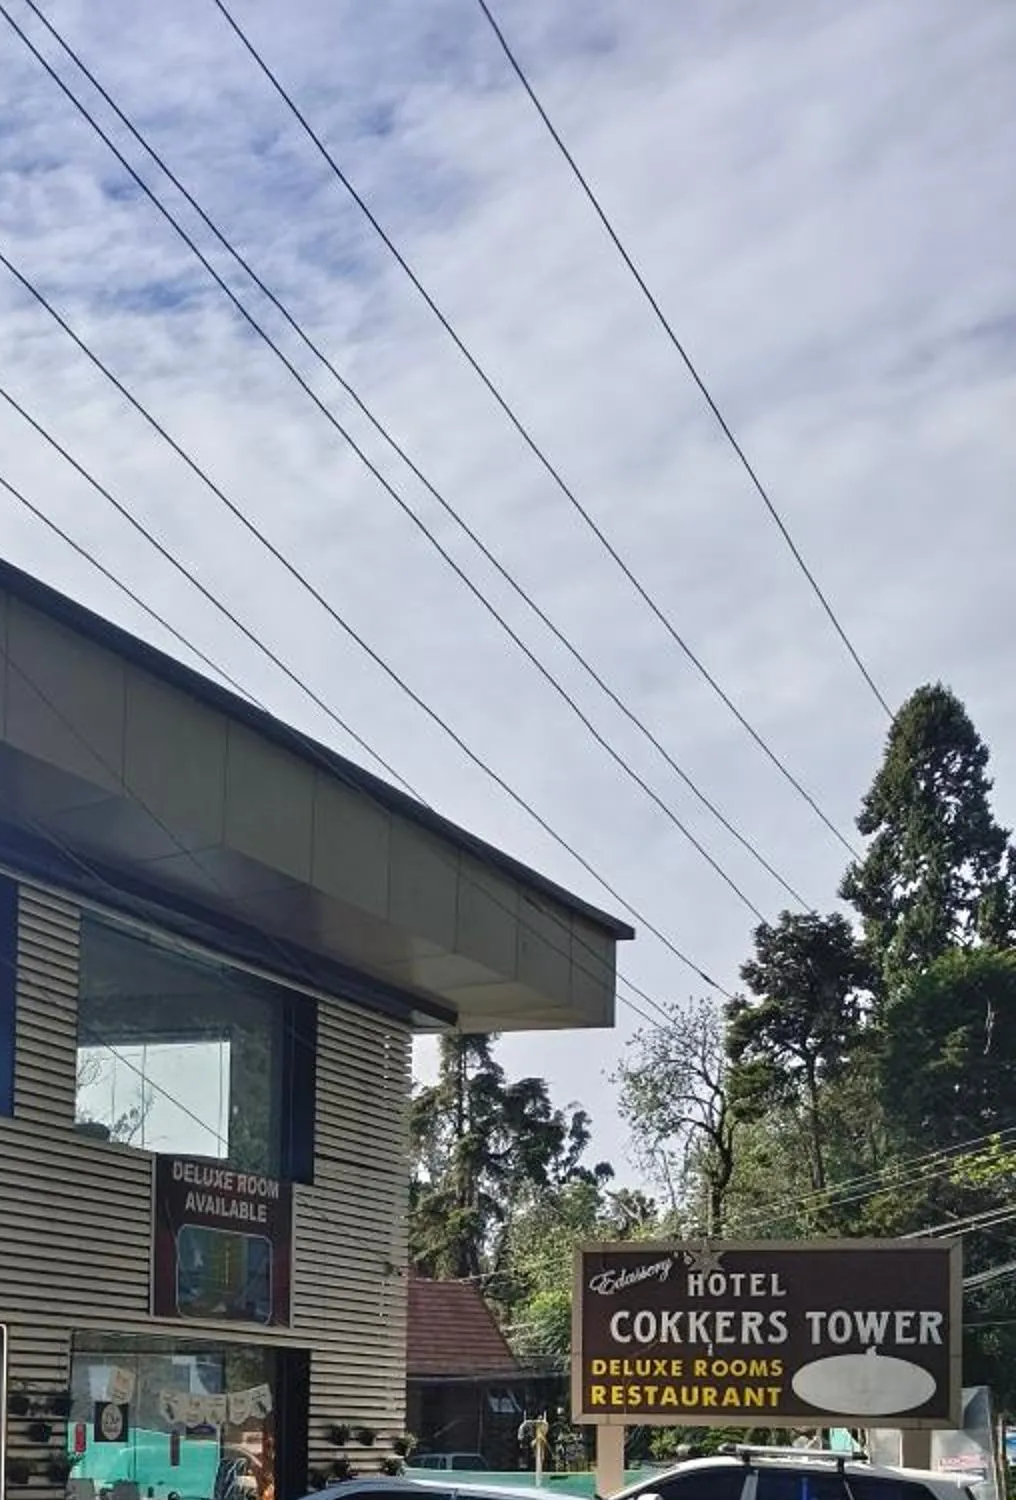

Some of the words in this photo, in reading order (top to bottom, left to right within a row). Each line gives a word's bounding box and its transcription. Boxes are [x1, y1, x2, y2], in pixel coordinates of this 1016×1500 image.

[172, 1159, 234, 1192] DELUXE
[236, 1174, 280, 1200] ROOM
[184, 1191, 267, 1224] AVAILABLE
[687, 1273, 787, 1297] HOTEL
[610, 1310, 788, 1345] COKKERS
[805, 1310, 944, 1346] TOWER
[592, 1359, 683, 1377] DELUXE
[694, 1359, 783, 1377] ROOMS
[591, 1385, 782, 1408] RESTAURANT
